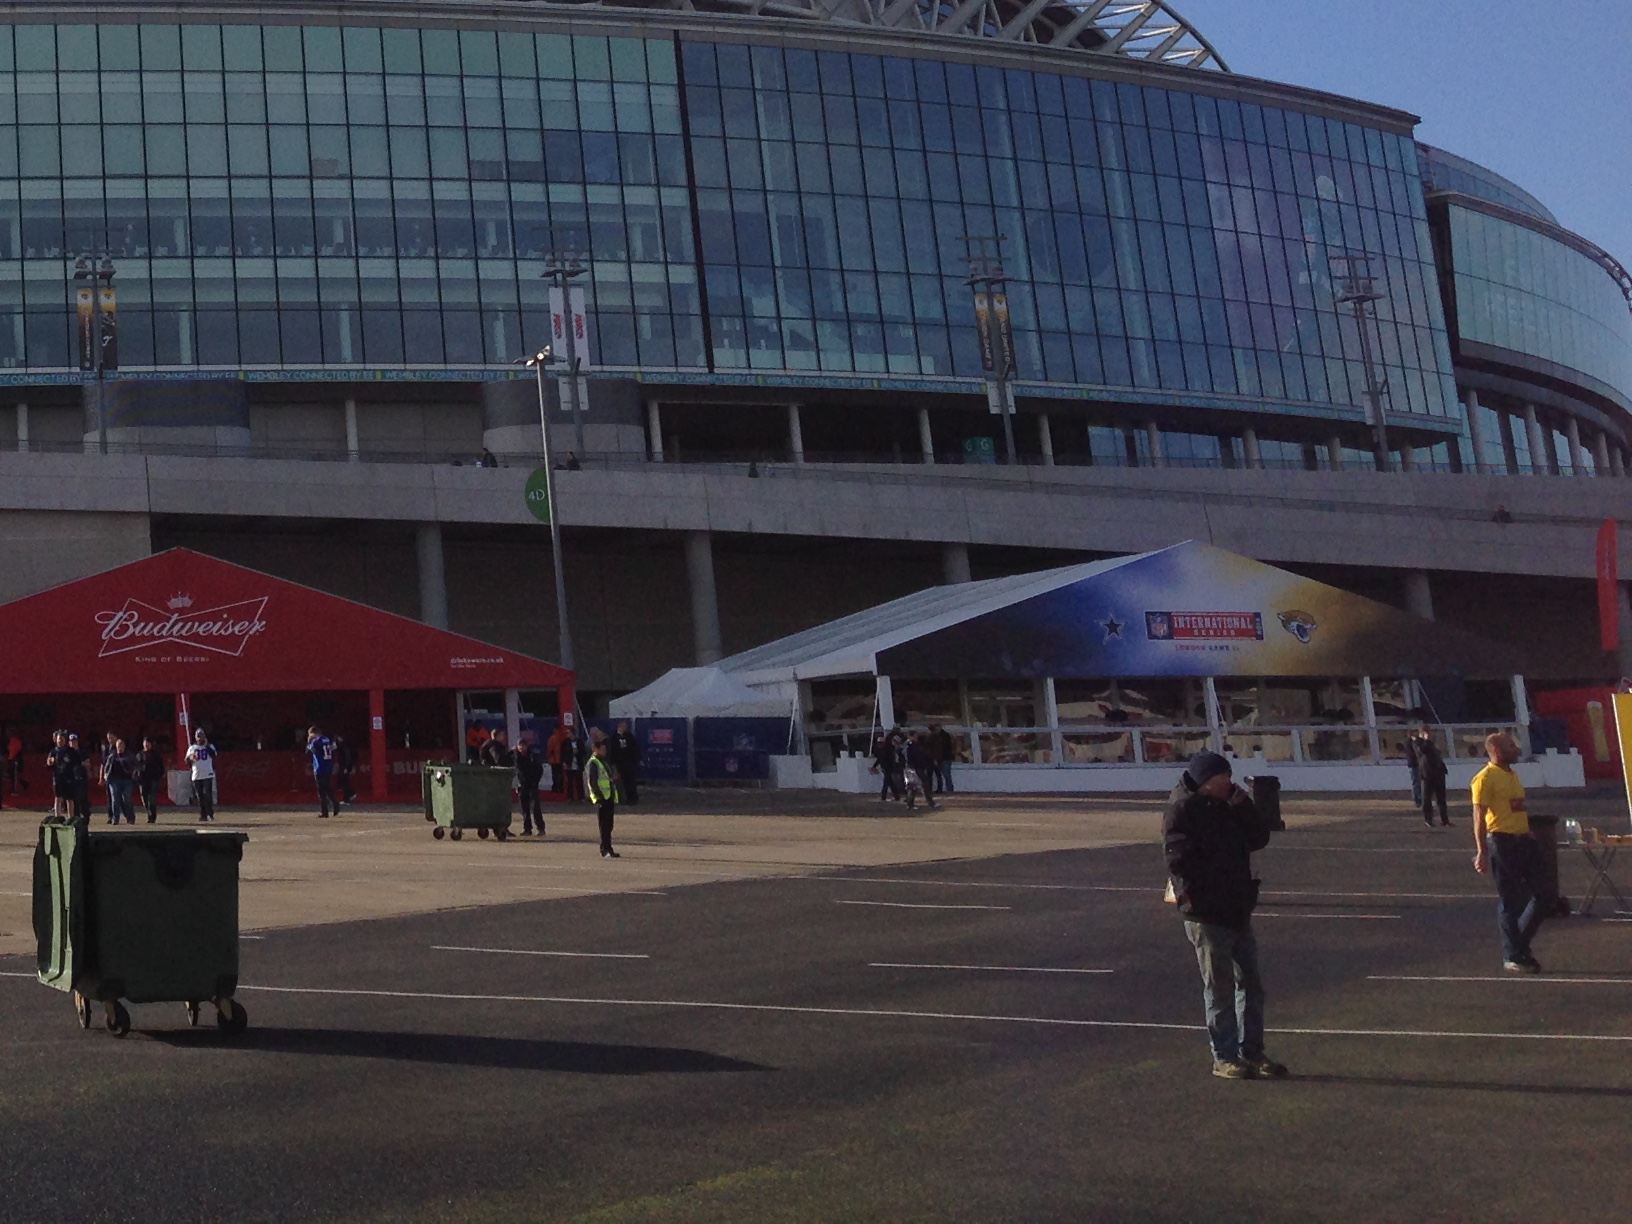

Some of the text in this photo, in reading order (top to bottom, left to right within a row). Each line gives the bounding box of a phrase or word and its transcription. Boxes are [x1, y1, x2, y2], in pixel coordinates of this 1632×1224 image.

[980, 438, 989, 450] G
[528, 488, 545, 501] 4D
[94, 610, 266, 640] Budweiser
[1173, 616, 1253, 629] INTERNATIONAL
